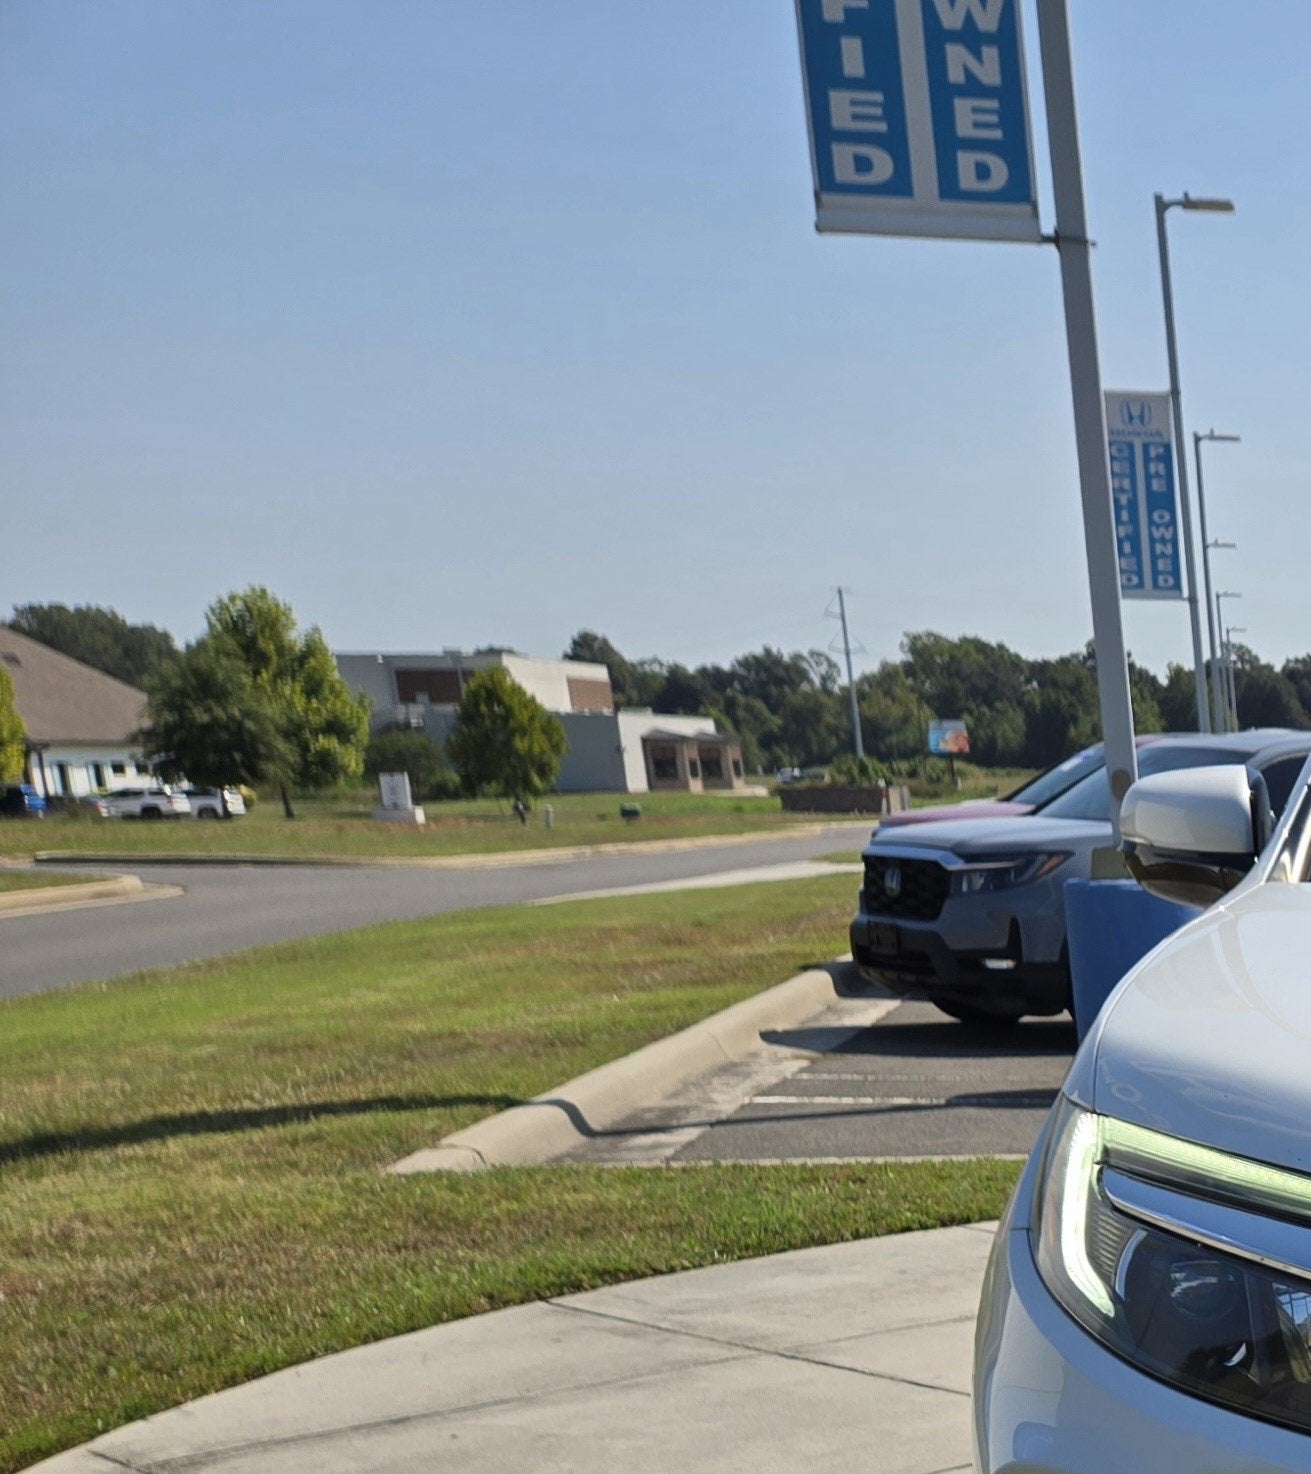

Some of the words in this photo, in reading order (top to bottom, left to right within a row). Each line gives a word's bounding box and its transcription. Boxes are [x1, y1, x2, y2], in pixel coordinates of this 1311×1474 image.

[1149, 443, 1168, 492] PRE
[1110, 443, 1140, 587] CERTIFIED
[1151, 508, 1175, 588] OWNED
